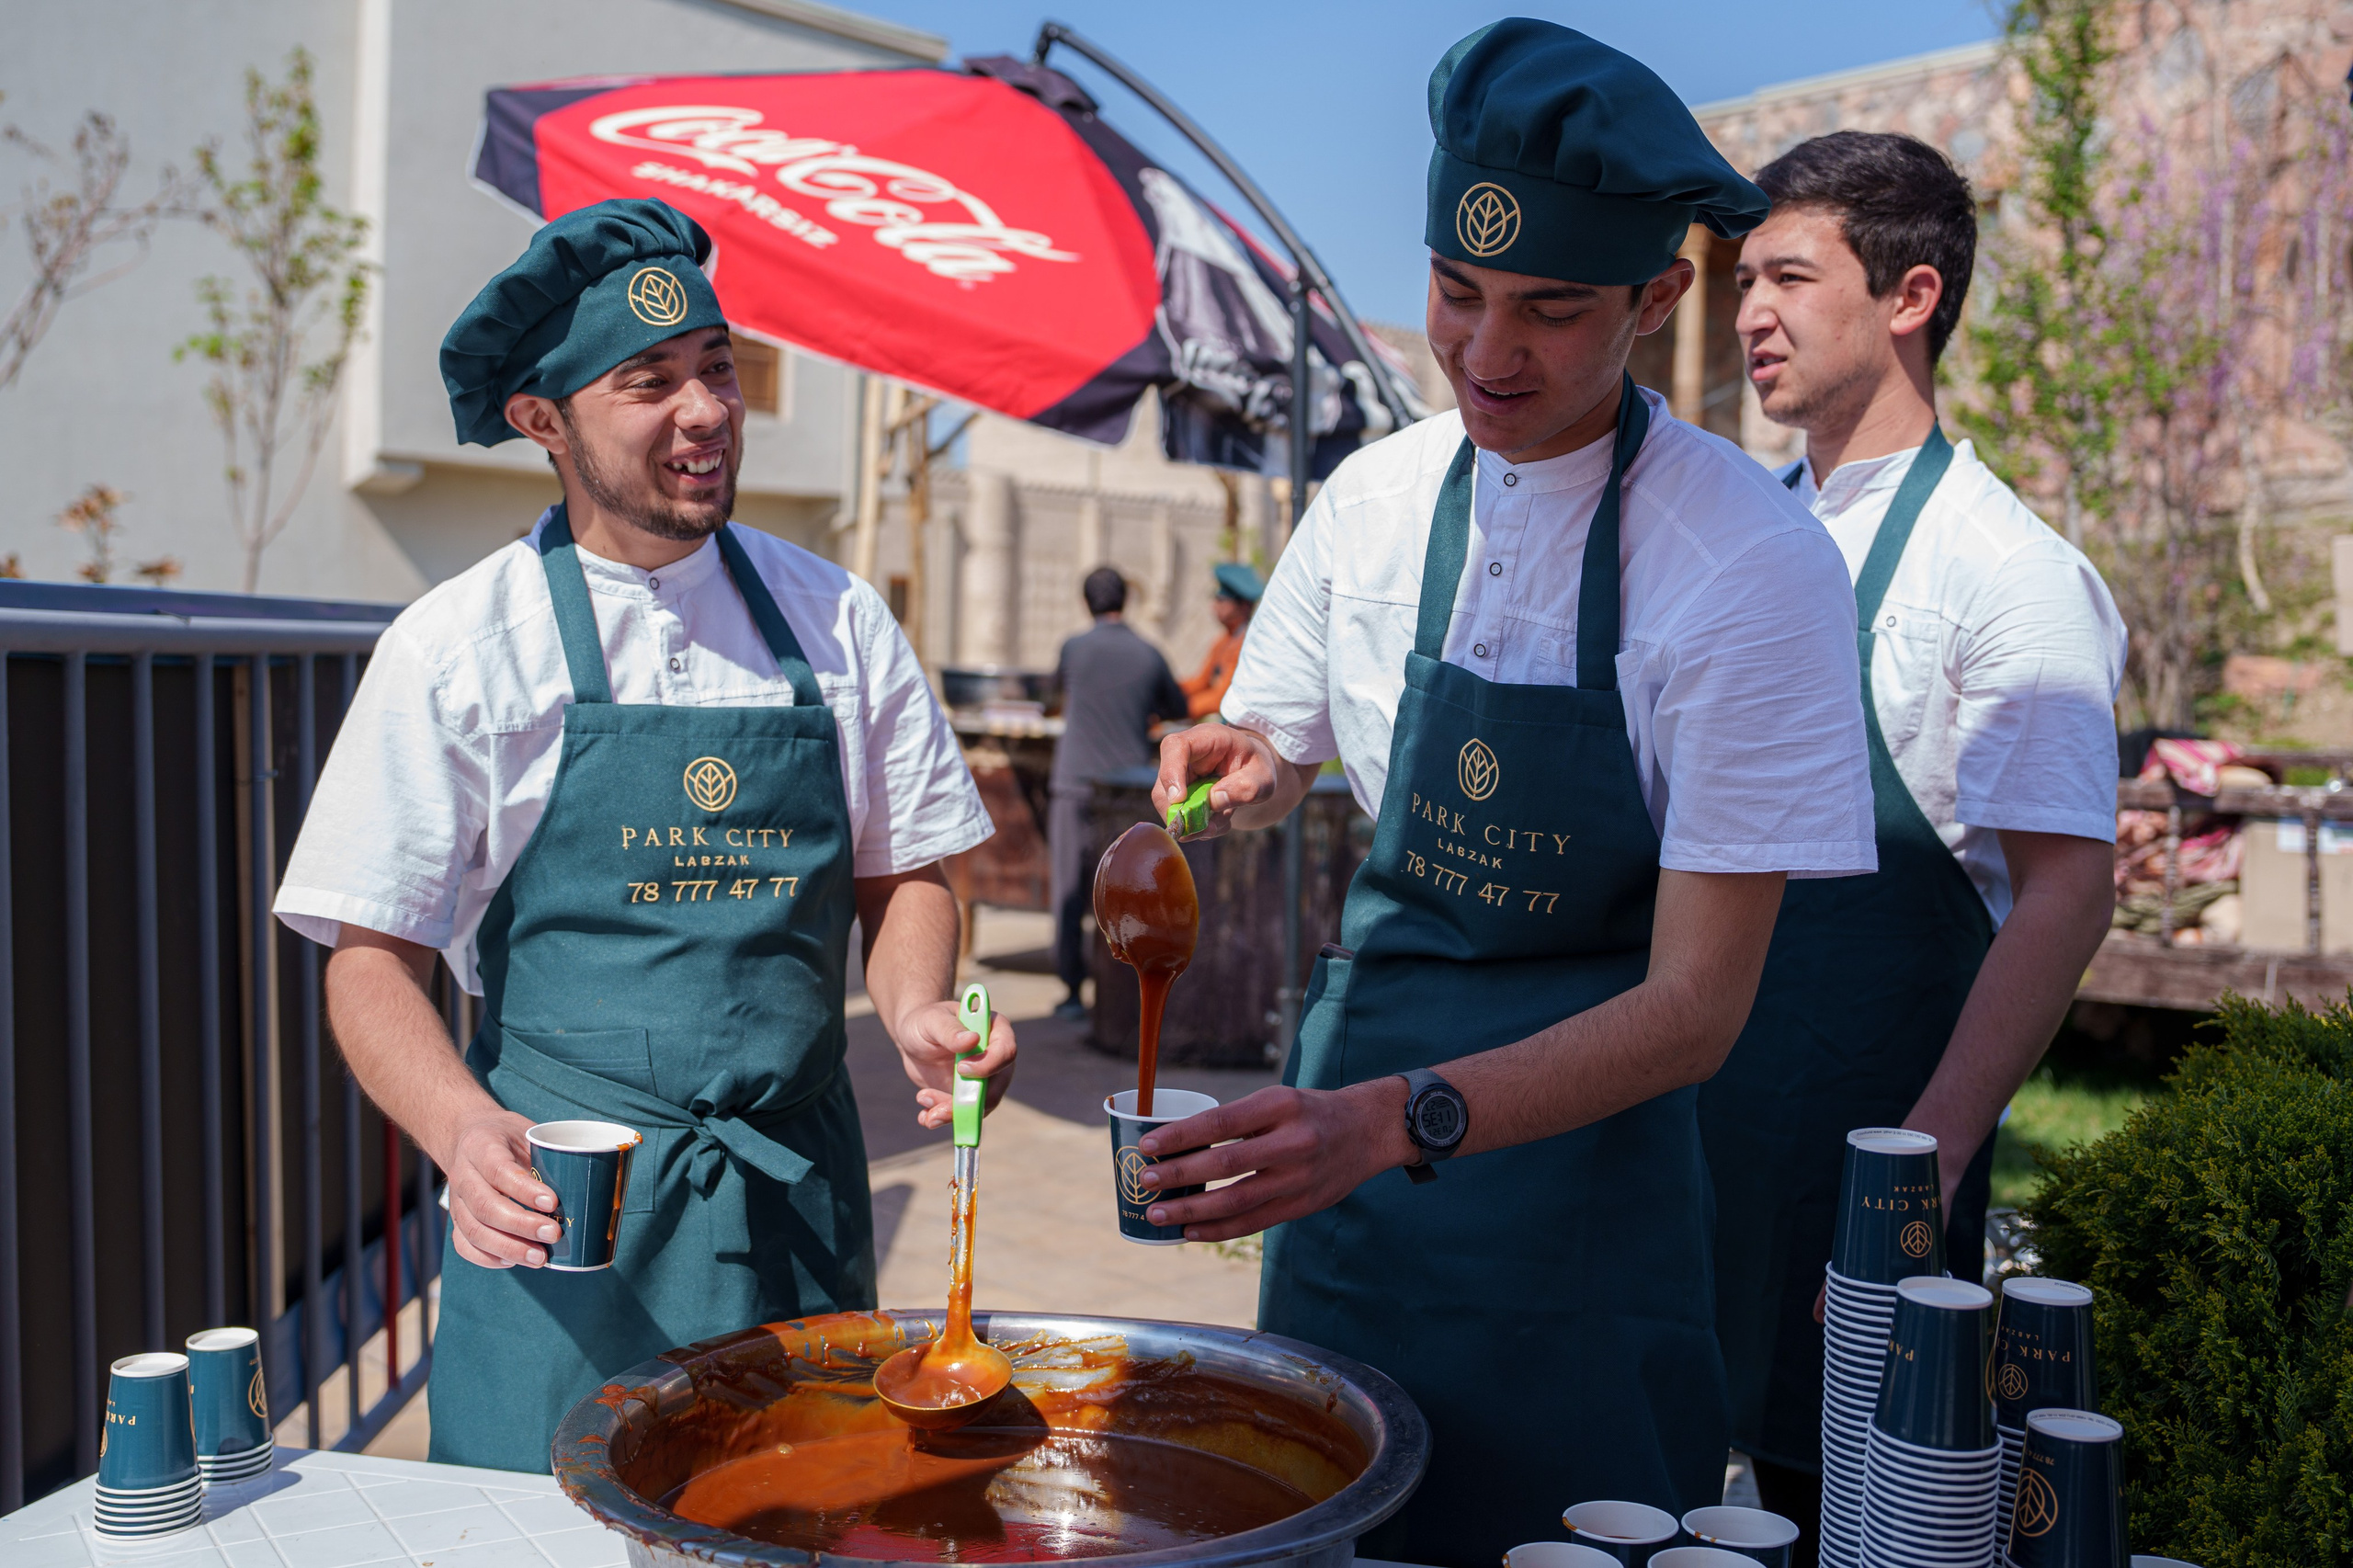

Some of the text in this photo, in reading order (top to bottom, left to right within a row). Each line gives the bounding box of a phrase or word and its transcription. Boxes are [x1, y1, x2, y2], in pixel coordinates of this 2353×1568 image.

[589, 105, 1080, 283] Coca-Cola
[1412, 792, 1571, 855] PARK CITY
[621, 825, 793, 850] PARK CITY
[675, 855, 750, 868] LABZAK
[1438, 838, 1503, 869] LABZAK
[627, 877, 799, 903] 78 777 47 77
[1406, 850, 1560, 915] 78 777 47 77
[1893, 1183, 1935, 1192] LABZAK
[1861, 1195, 1941, 1211] RK CITY
[1887, 1338, 1915, 1362] PAR
[1995, 1336, 2071, 1363] PARK CI
